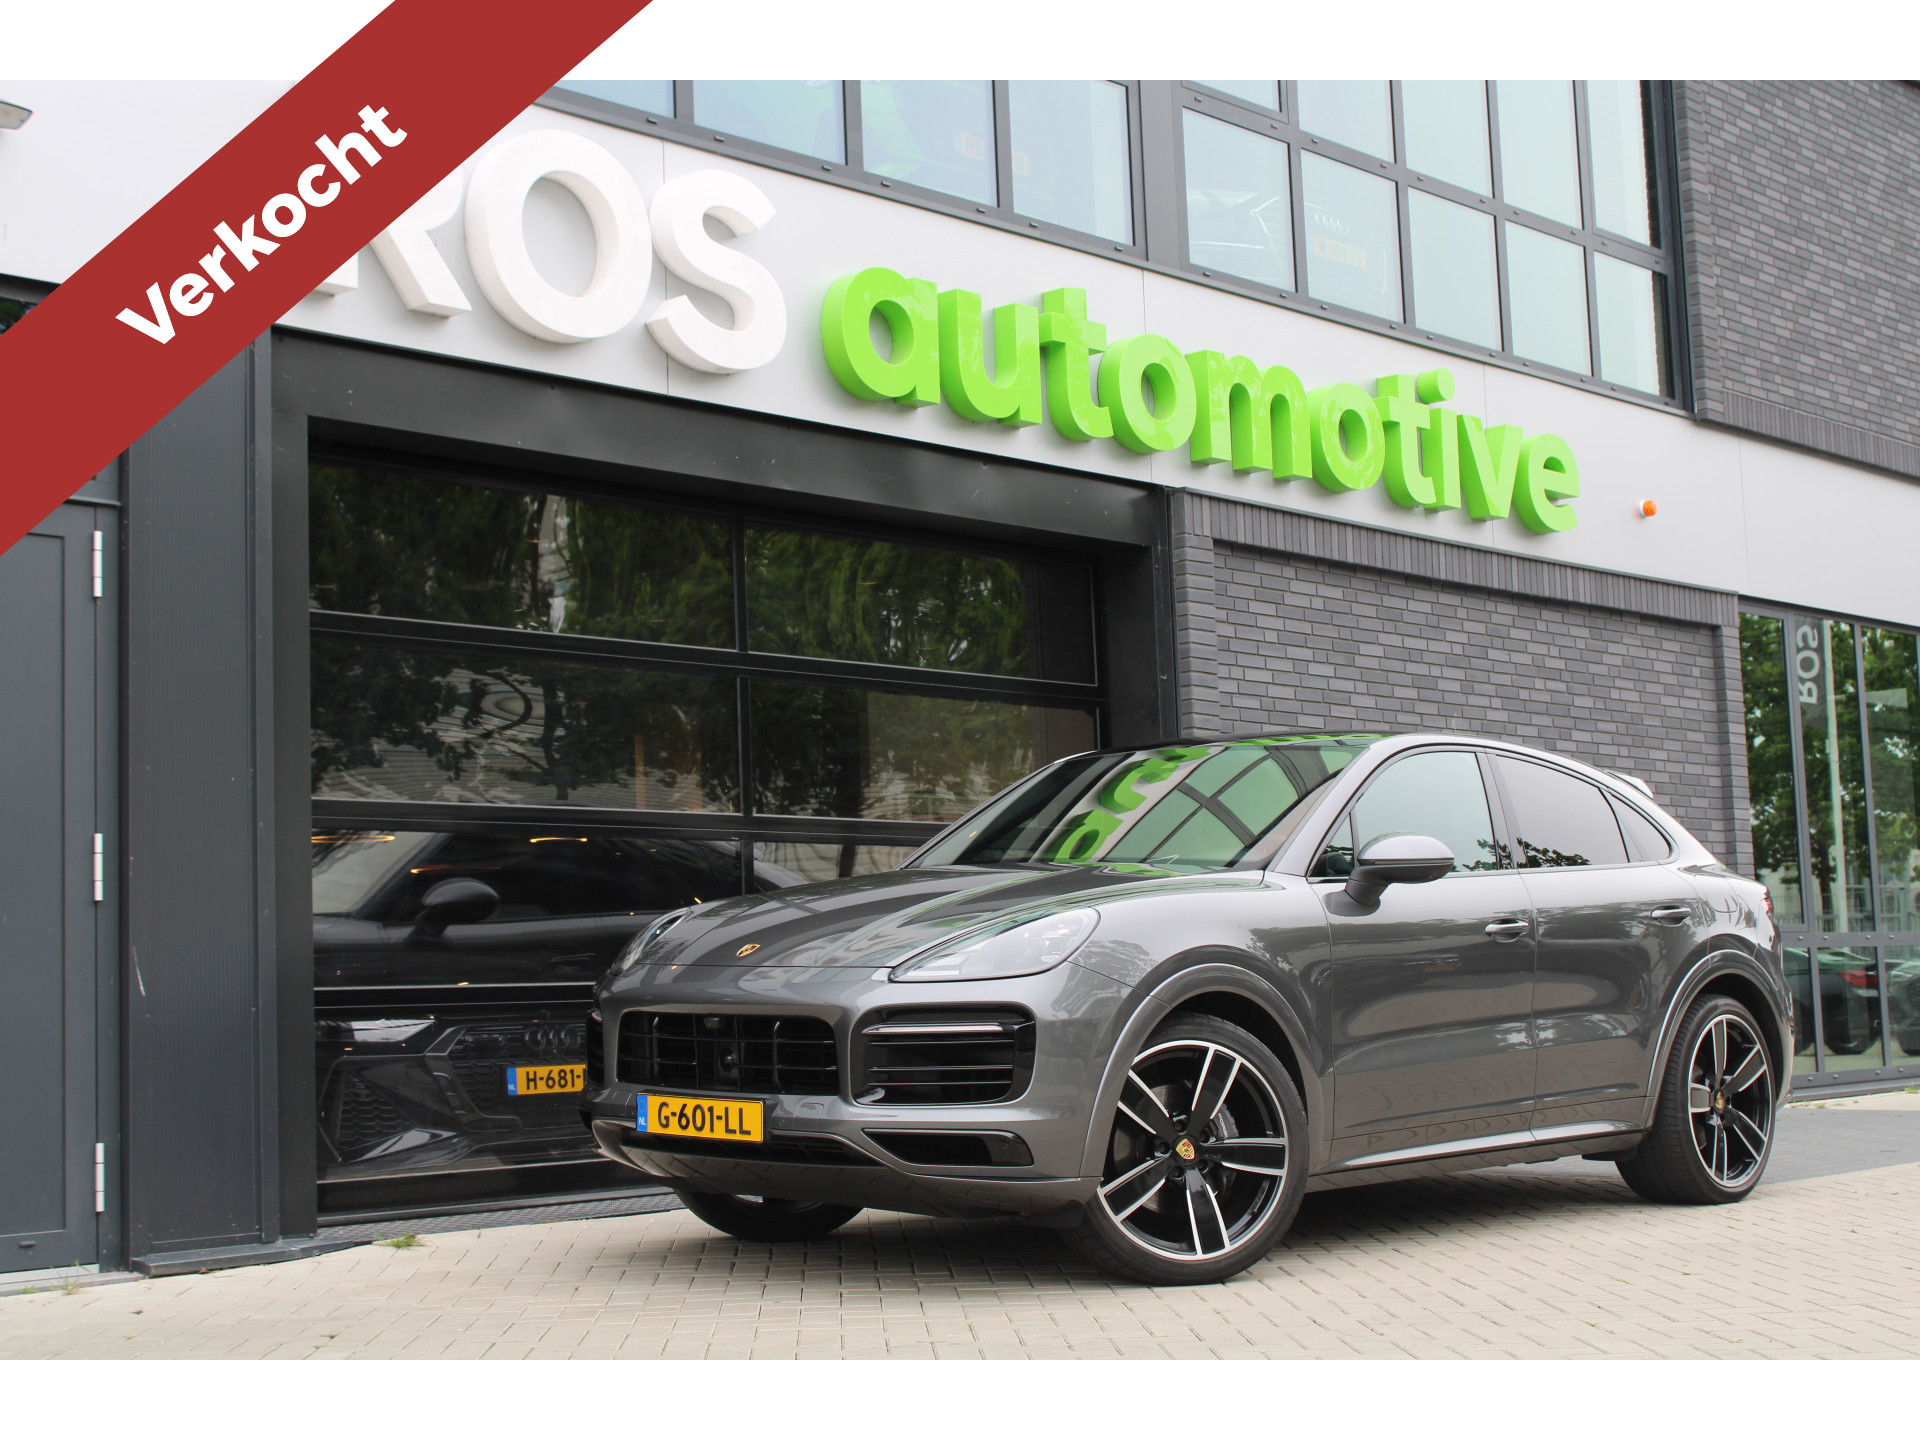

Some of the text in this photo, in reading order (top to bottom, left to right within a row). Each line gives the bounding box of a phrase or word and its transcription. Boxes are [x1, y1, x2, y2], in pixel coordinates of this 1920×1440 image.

[820, 267, 1580, 535] automotive
[526, 1068, 586, 1090] H-681-
[639, 1117, 646, 1126] NL
[658, 1102, 751, 1135] G-601-LL
